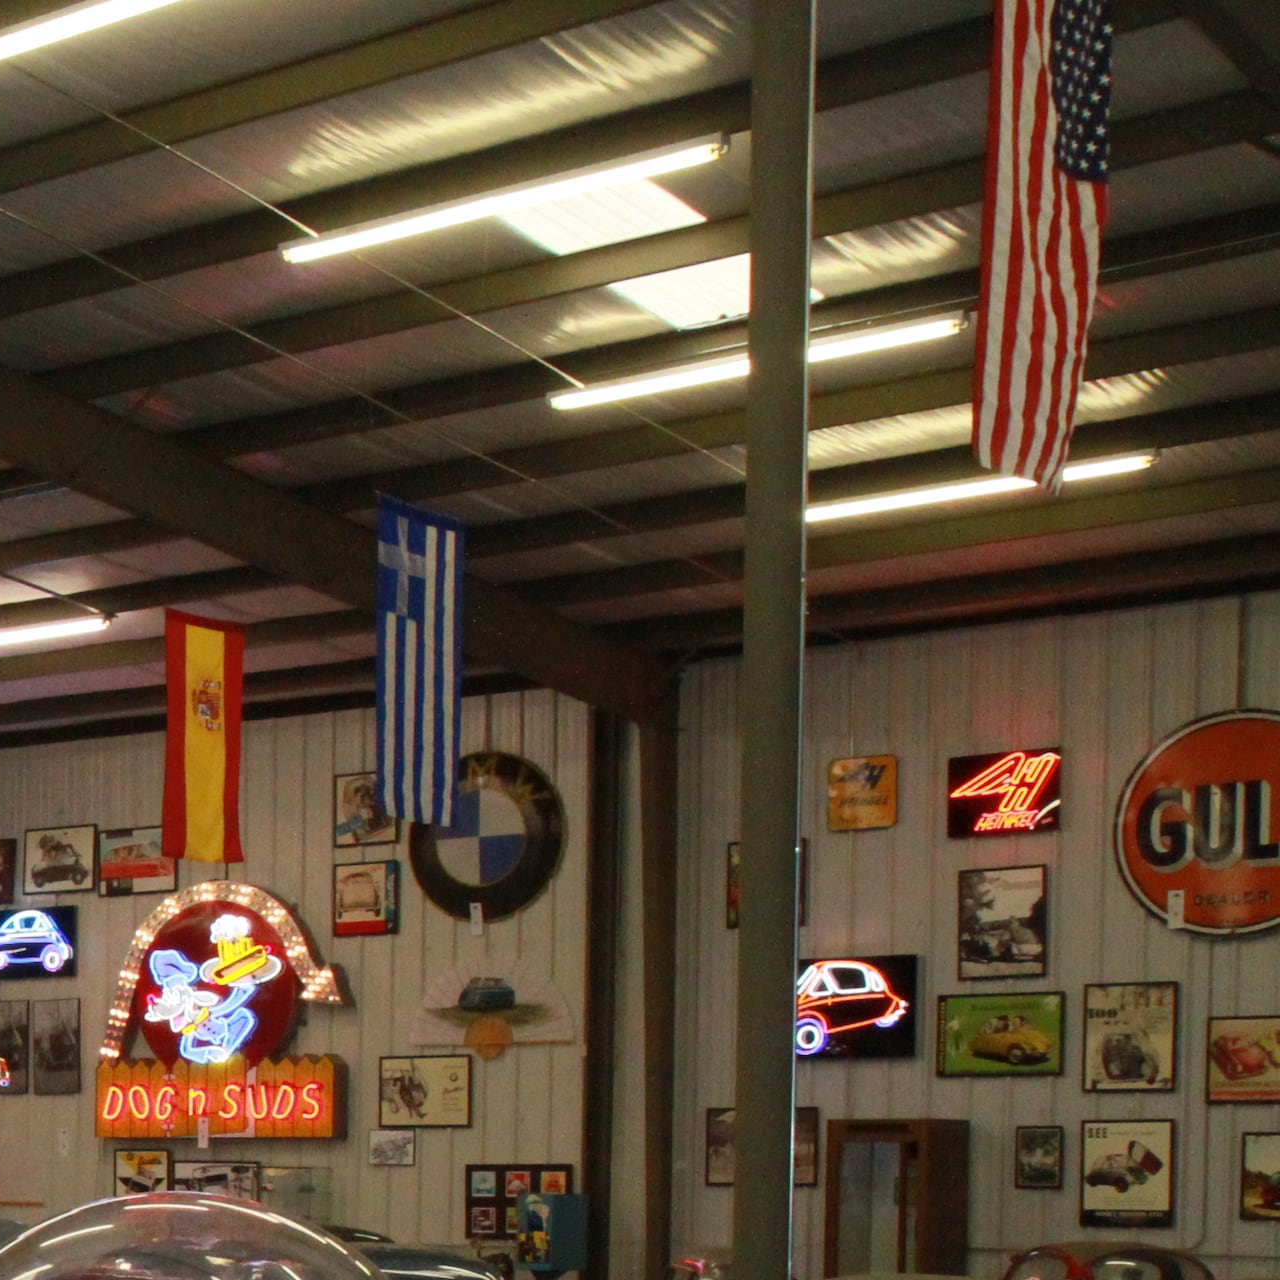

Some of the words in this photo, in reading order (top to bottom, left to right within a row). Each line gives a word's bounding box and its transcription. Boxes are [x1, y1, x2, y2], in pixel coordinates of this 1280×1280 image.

[974, 810, 1039, 832] HEINKEL
[1195, 890, 1272, 906] DEALER
[102, 1084, 176, 1120] DOG
[188, 1088, 207, 1117] n
[217, 1083, 322, 1120] SUDS
[1087, 1126, 1108, 1139] SEE
